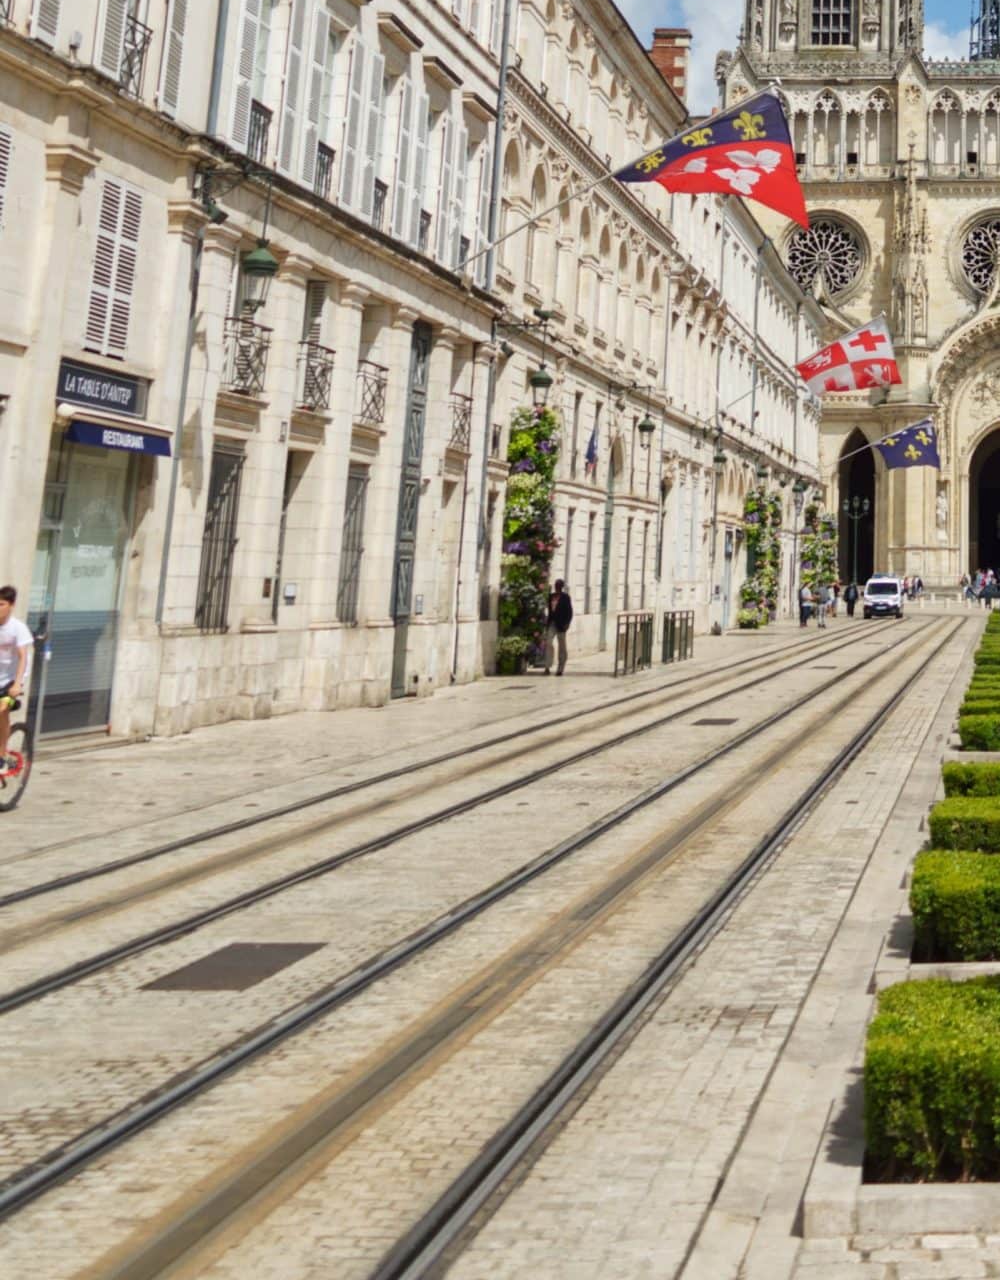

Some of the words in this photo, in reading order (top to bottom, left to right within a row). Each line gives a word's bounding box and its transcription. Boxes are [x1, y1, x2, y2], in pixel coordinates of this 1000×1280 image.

[65, 373, 76, 392] LA
[77, 377, 101, 398] TABLE
[102, 429, 144, 450] RESTAURANT
